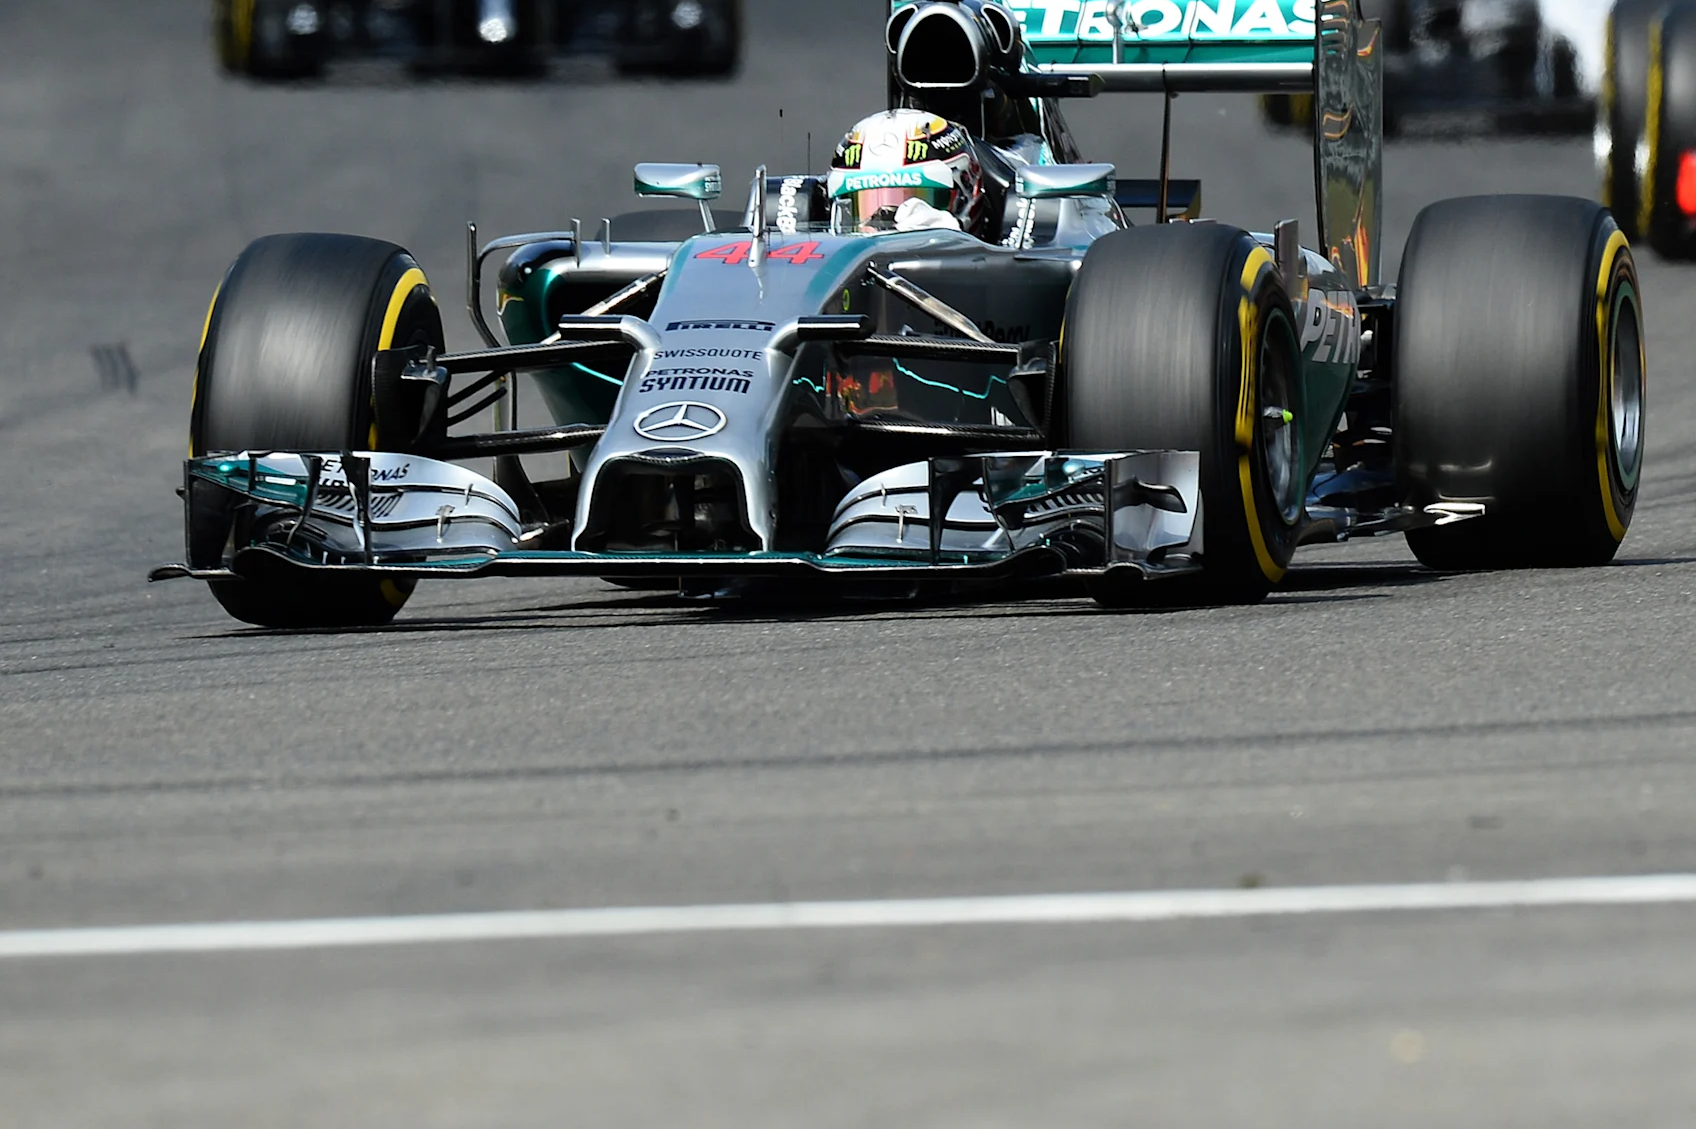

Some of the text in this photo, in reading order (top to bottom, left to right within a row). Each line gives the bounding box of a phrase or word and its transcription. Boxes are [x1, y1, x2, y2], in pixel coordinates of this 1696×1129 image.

[845, 172, 923, 190] PETRONAS
[694, 241, 824, 265] 44
[665, 319, 776, 331] PIRELLI
[654, 348, 763, 361] SWISSQUOTE
[646, 367, 754, 378] PETRONAS
[639, 376, 751, 394] SYNTIUM
